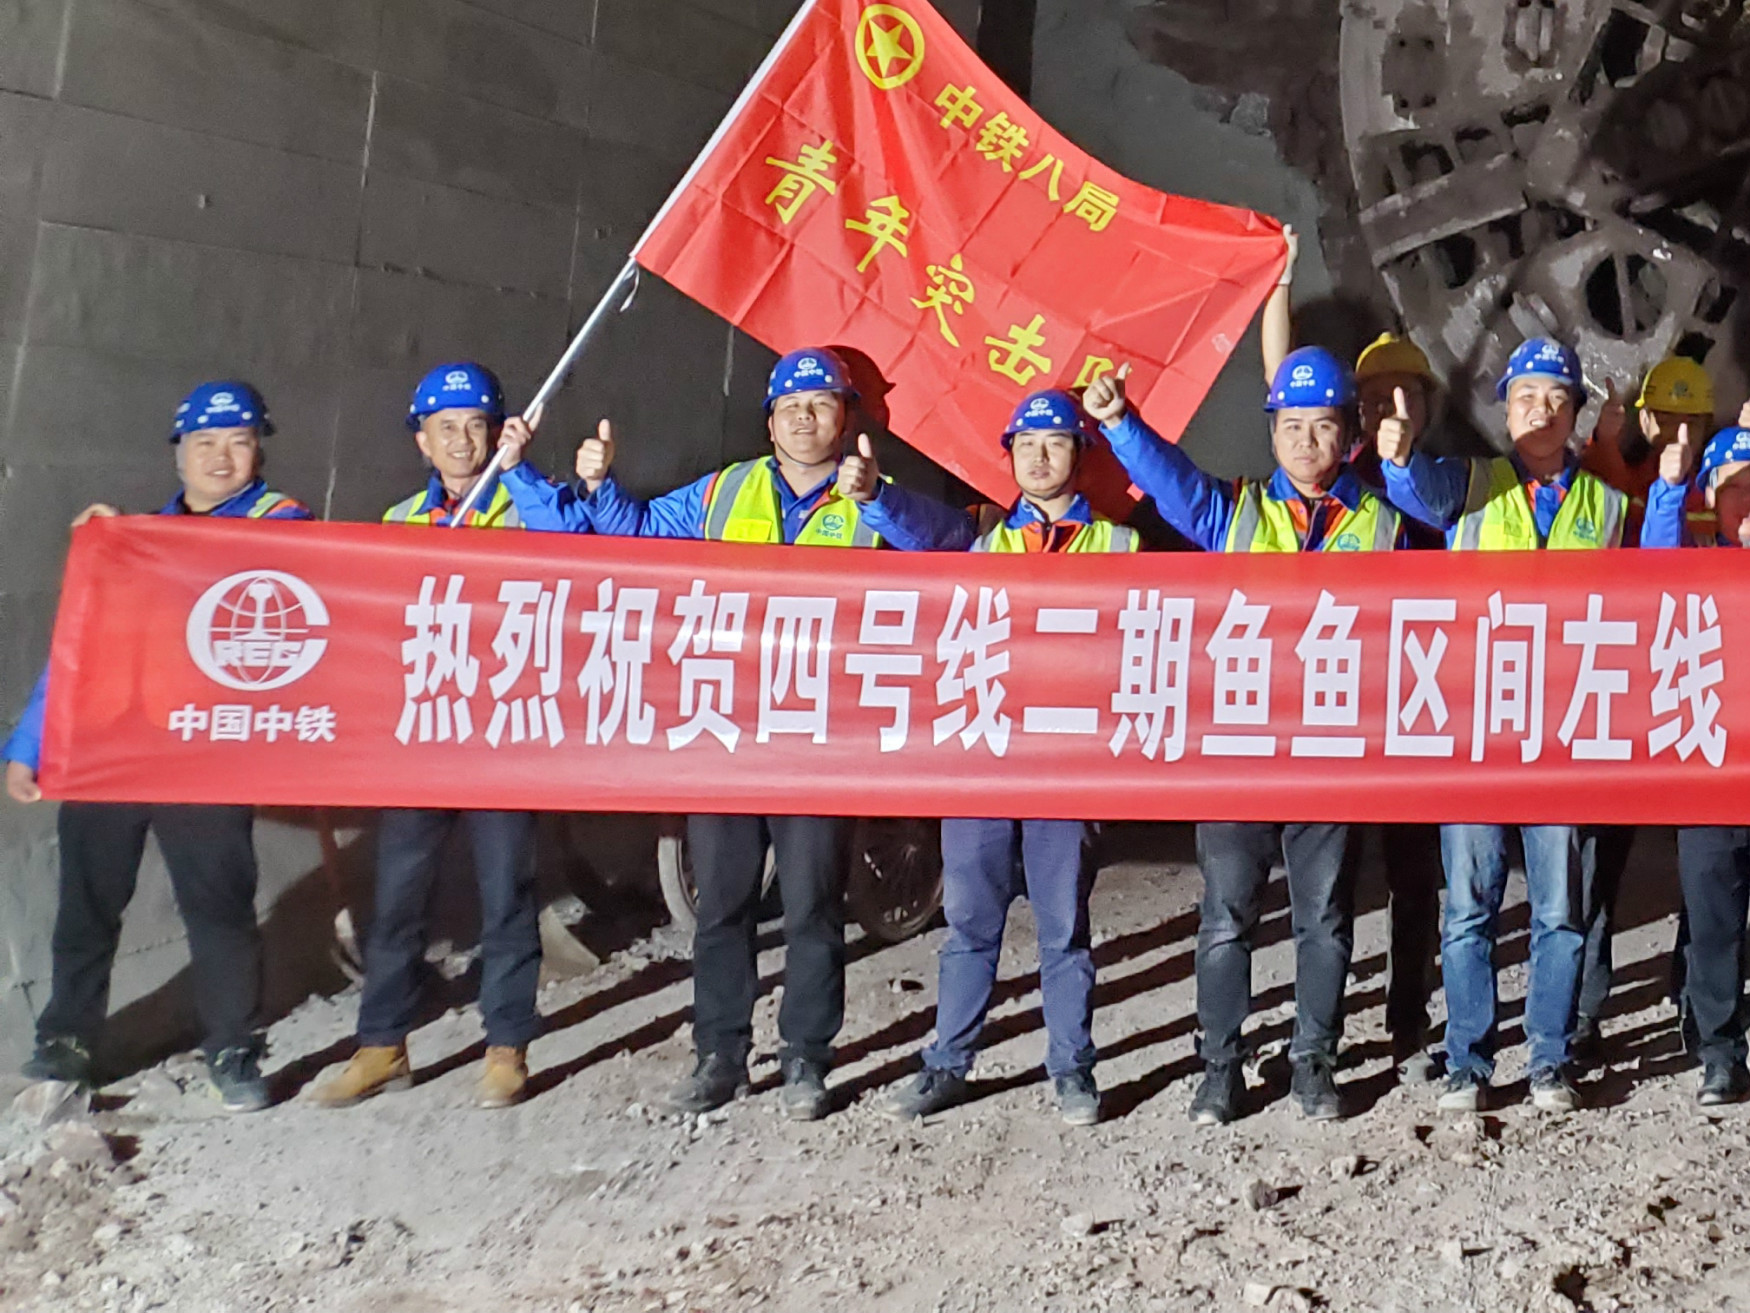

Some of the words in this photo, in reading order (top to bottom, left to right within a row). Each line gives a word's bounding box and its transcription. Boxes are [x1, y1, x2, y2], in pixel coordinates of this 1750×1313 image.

[934, 84, 1120, 233] 中铁八局
[168, 703, 337, 743] 中国中铁
